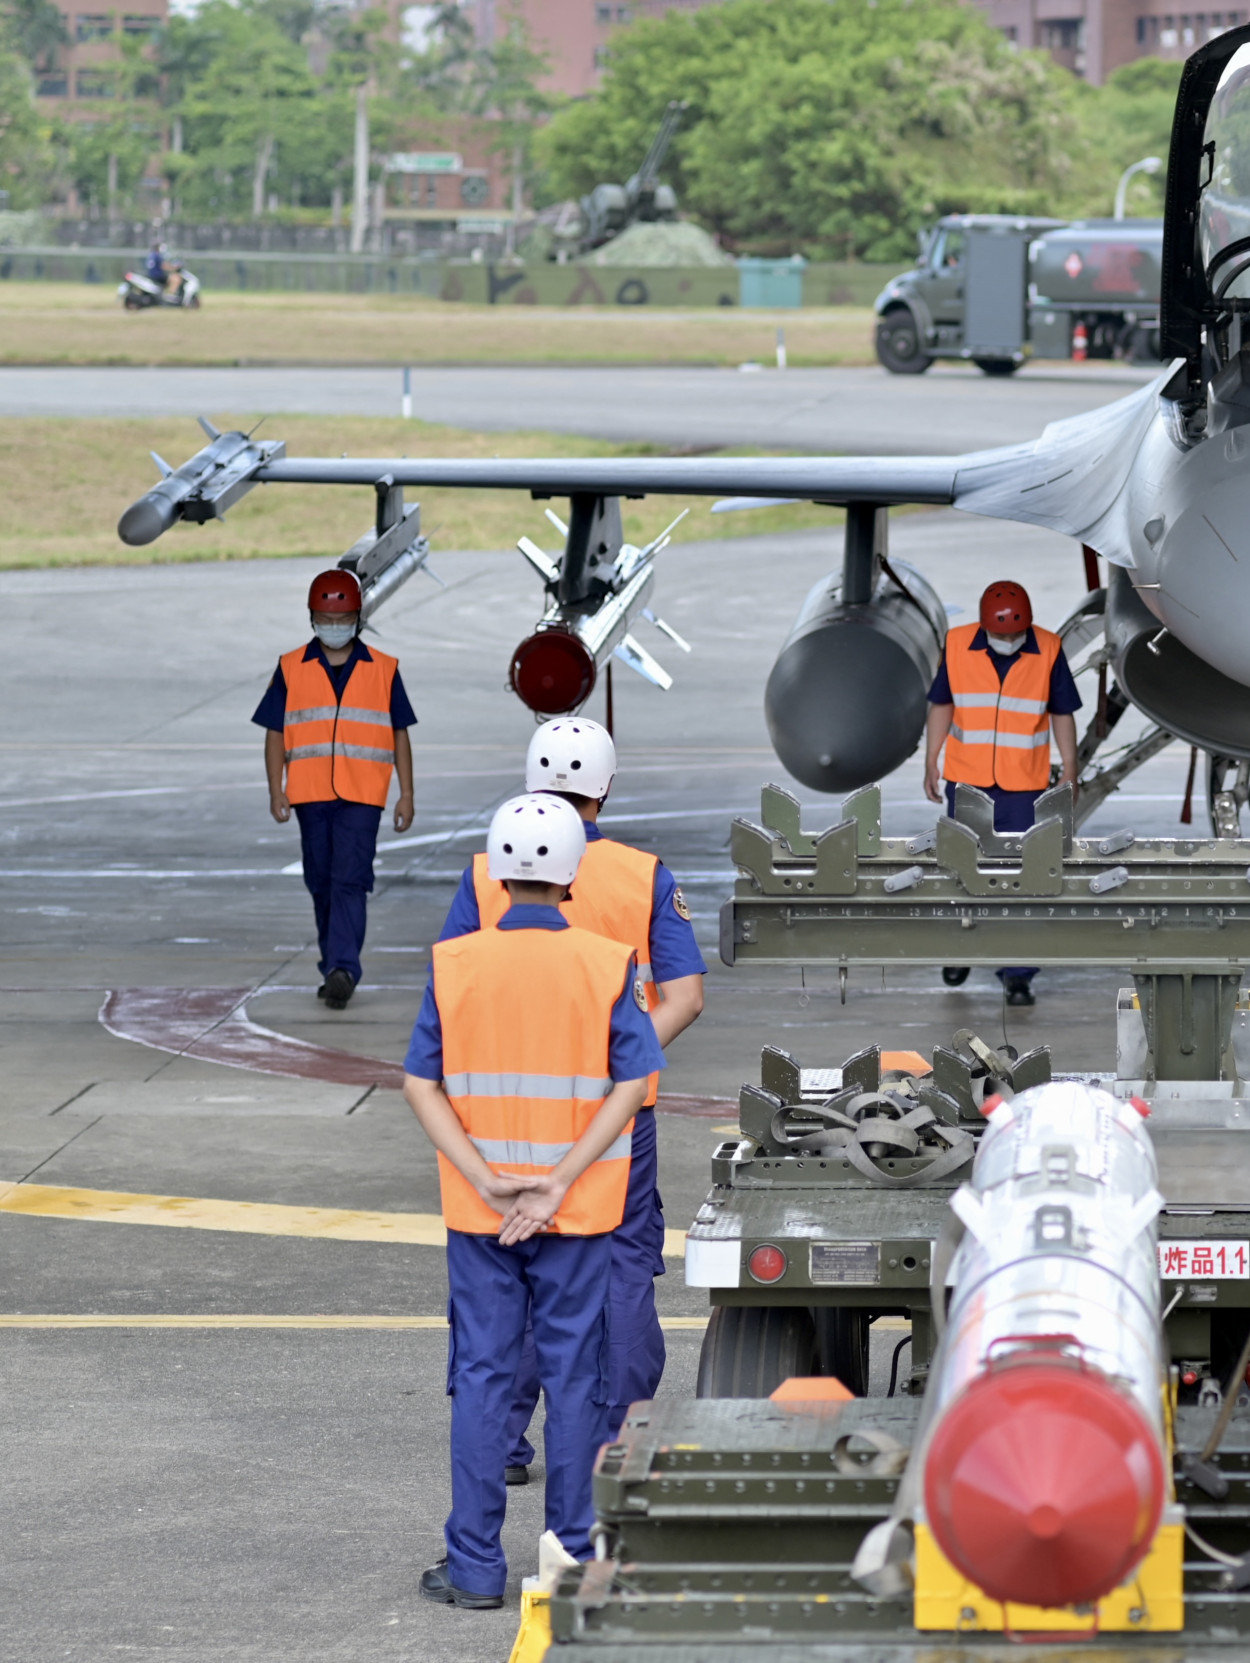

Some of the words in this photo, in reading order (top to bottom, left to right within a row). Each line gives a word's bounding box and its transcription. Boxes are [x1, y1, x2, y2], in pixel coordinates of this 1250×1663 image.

[932, 908, 943, 916] 12
[978, 908, 988, 916] 10
[1002, 908, 1008, 916] 9
[1025, 908, 1031, 916] 8
[1048, 908, 1054, 916] 7
[1070, 908, 1077, 916] 6
[1093, 908, 1100, 916] 5
[1116, 908, 1122, 916] 4
[1139, 908, 1145, 916] 3
[1162, 908, 1168, 916] 2
[1207, 908, 1213, 916] 2
[1230, 908, 1236, 916] 3
[1157, 1246, 1243, 1275] 炸品1.1
